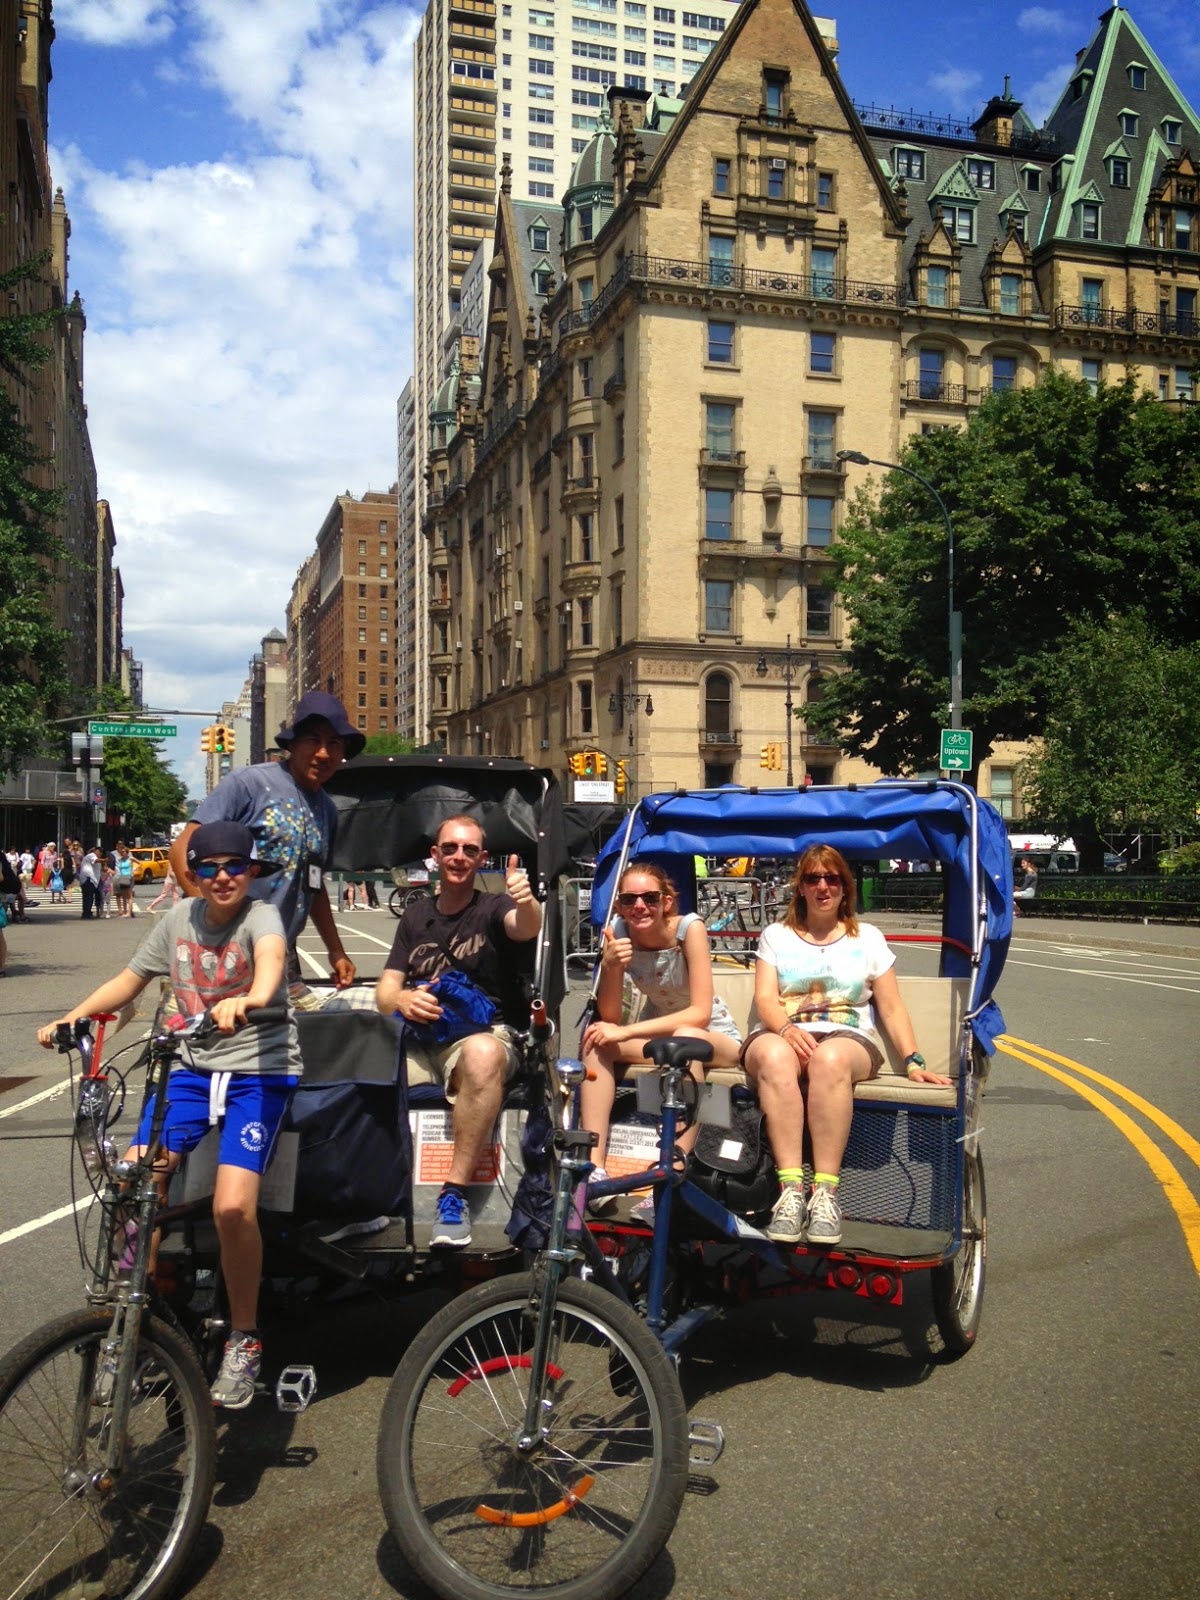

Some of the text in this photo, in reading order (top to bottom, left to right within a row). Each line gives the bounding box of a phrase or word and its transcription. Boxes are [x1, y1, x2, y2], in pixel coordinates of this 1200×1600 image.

[130, 726, 152, 734] Park
[154, 727, 176, 735] West
[944, 747, 969, 755] Uptown
